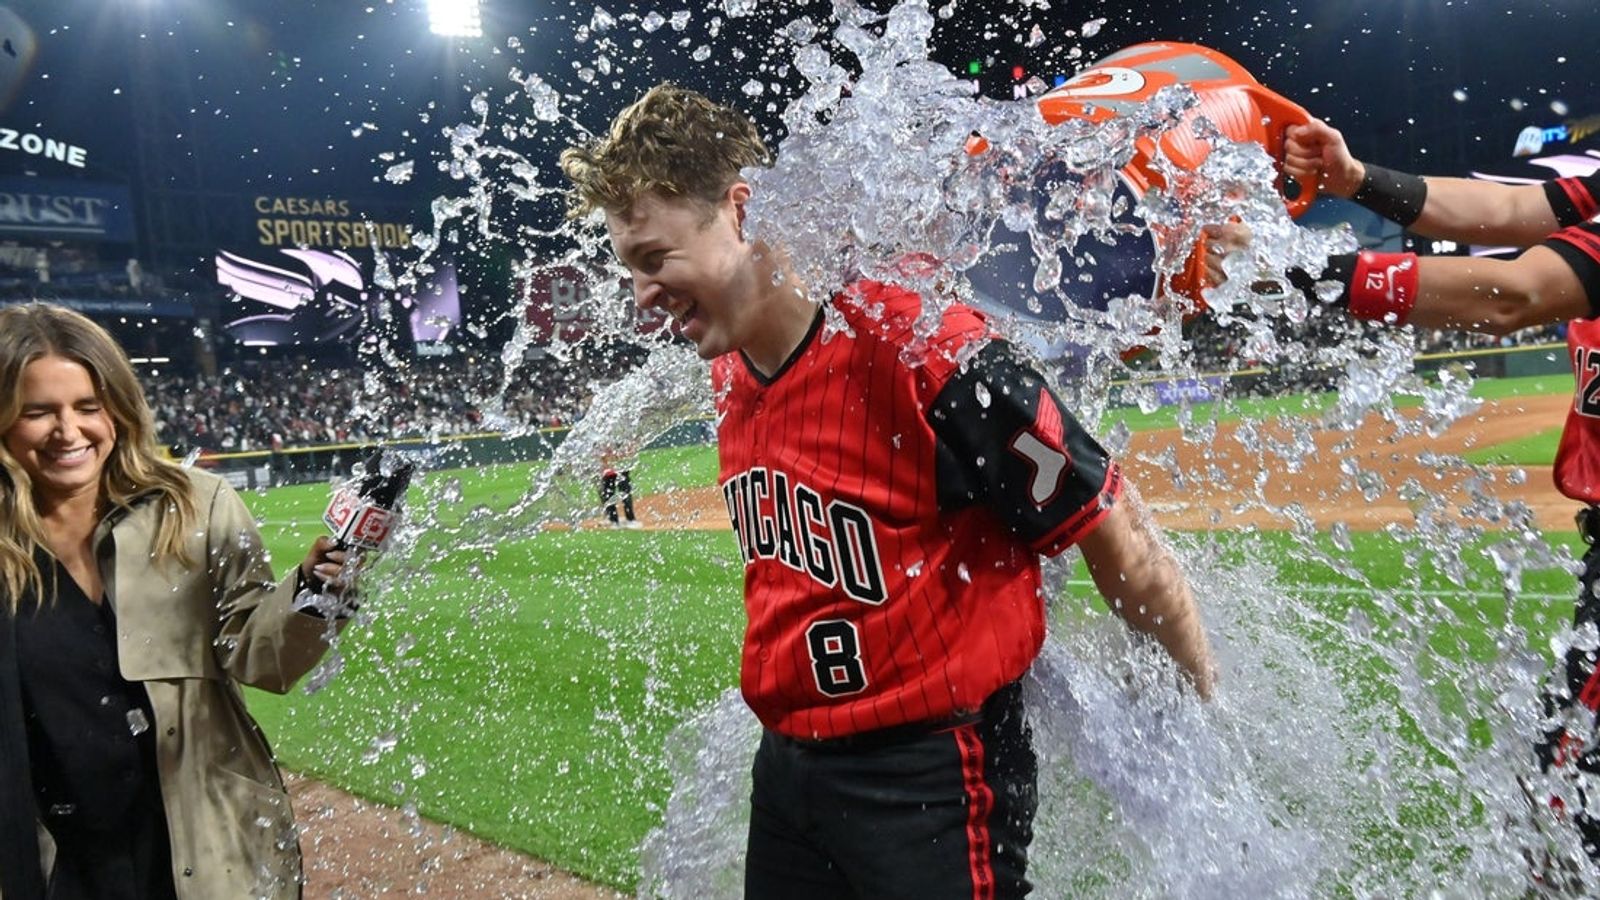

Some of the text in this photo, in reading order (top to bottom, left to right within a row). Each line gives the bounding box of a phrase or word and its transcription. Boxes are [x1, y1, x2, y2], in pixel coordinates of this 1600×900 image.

[0, 127, 88, 169] ZONE
[254, 196, 350, 217] CAESARS
[1366, 272, 1385, 290] 12
[1575, 346, 1600, 418] 12
[721, 466, 889, 606] HICAGO
[805, 618, 869, 698] 8
